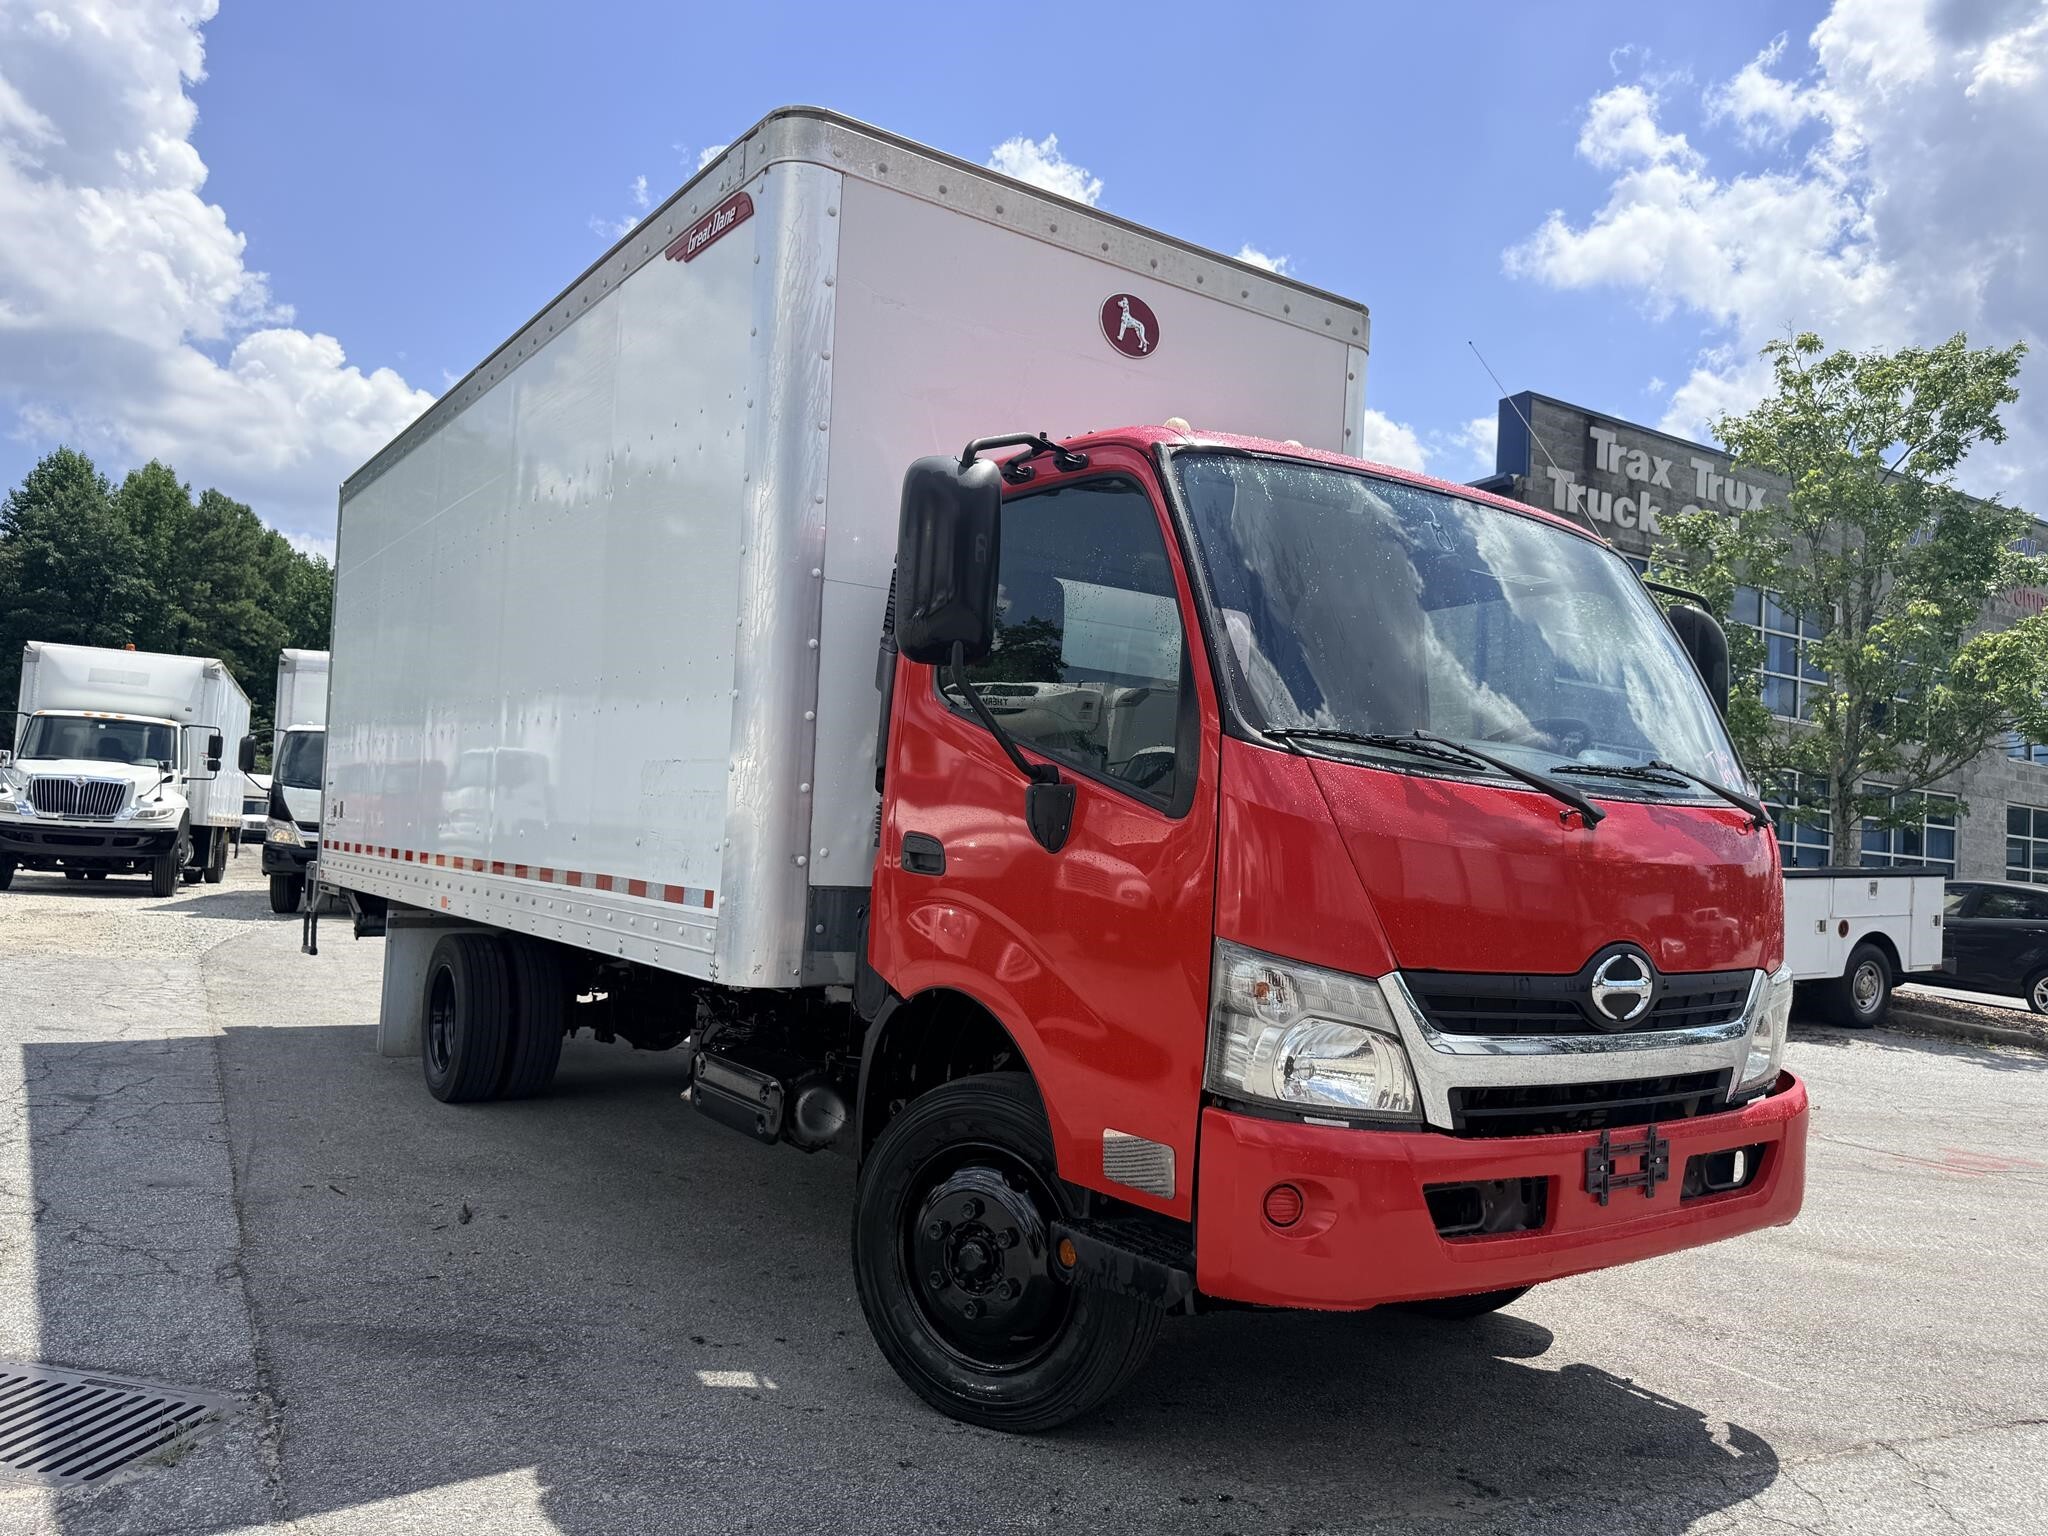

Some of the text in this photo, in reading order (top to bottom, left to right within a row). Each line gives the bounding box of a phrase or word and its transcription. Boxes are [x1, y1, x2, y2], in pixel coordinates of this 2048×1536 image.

[687, 206, 737, 254] Great Dane
[1546, 465, 1663, 536] Truck
[1589, 425, 1768, 511] Trax Trux
